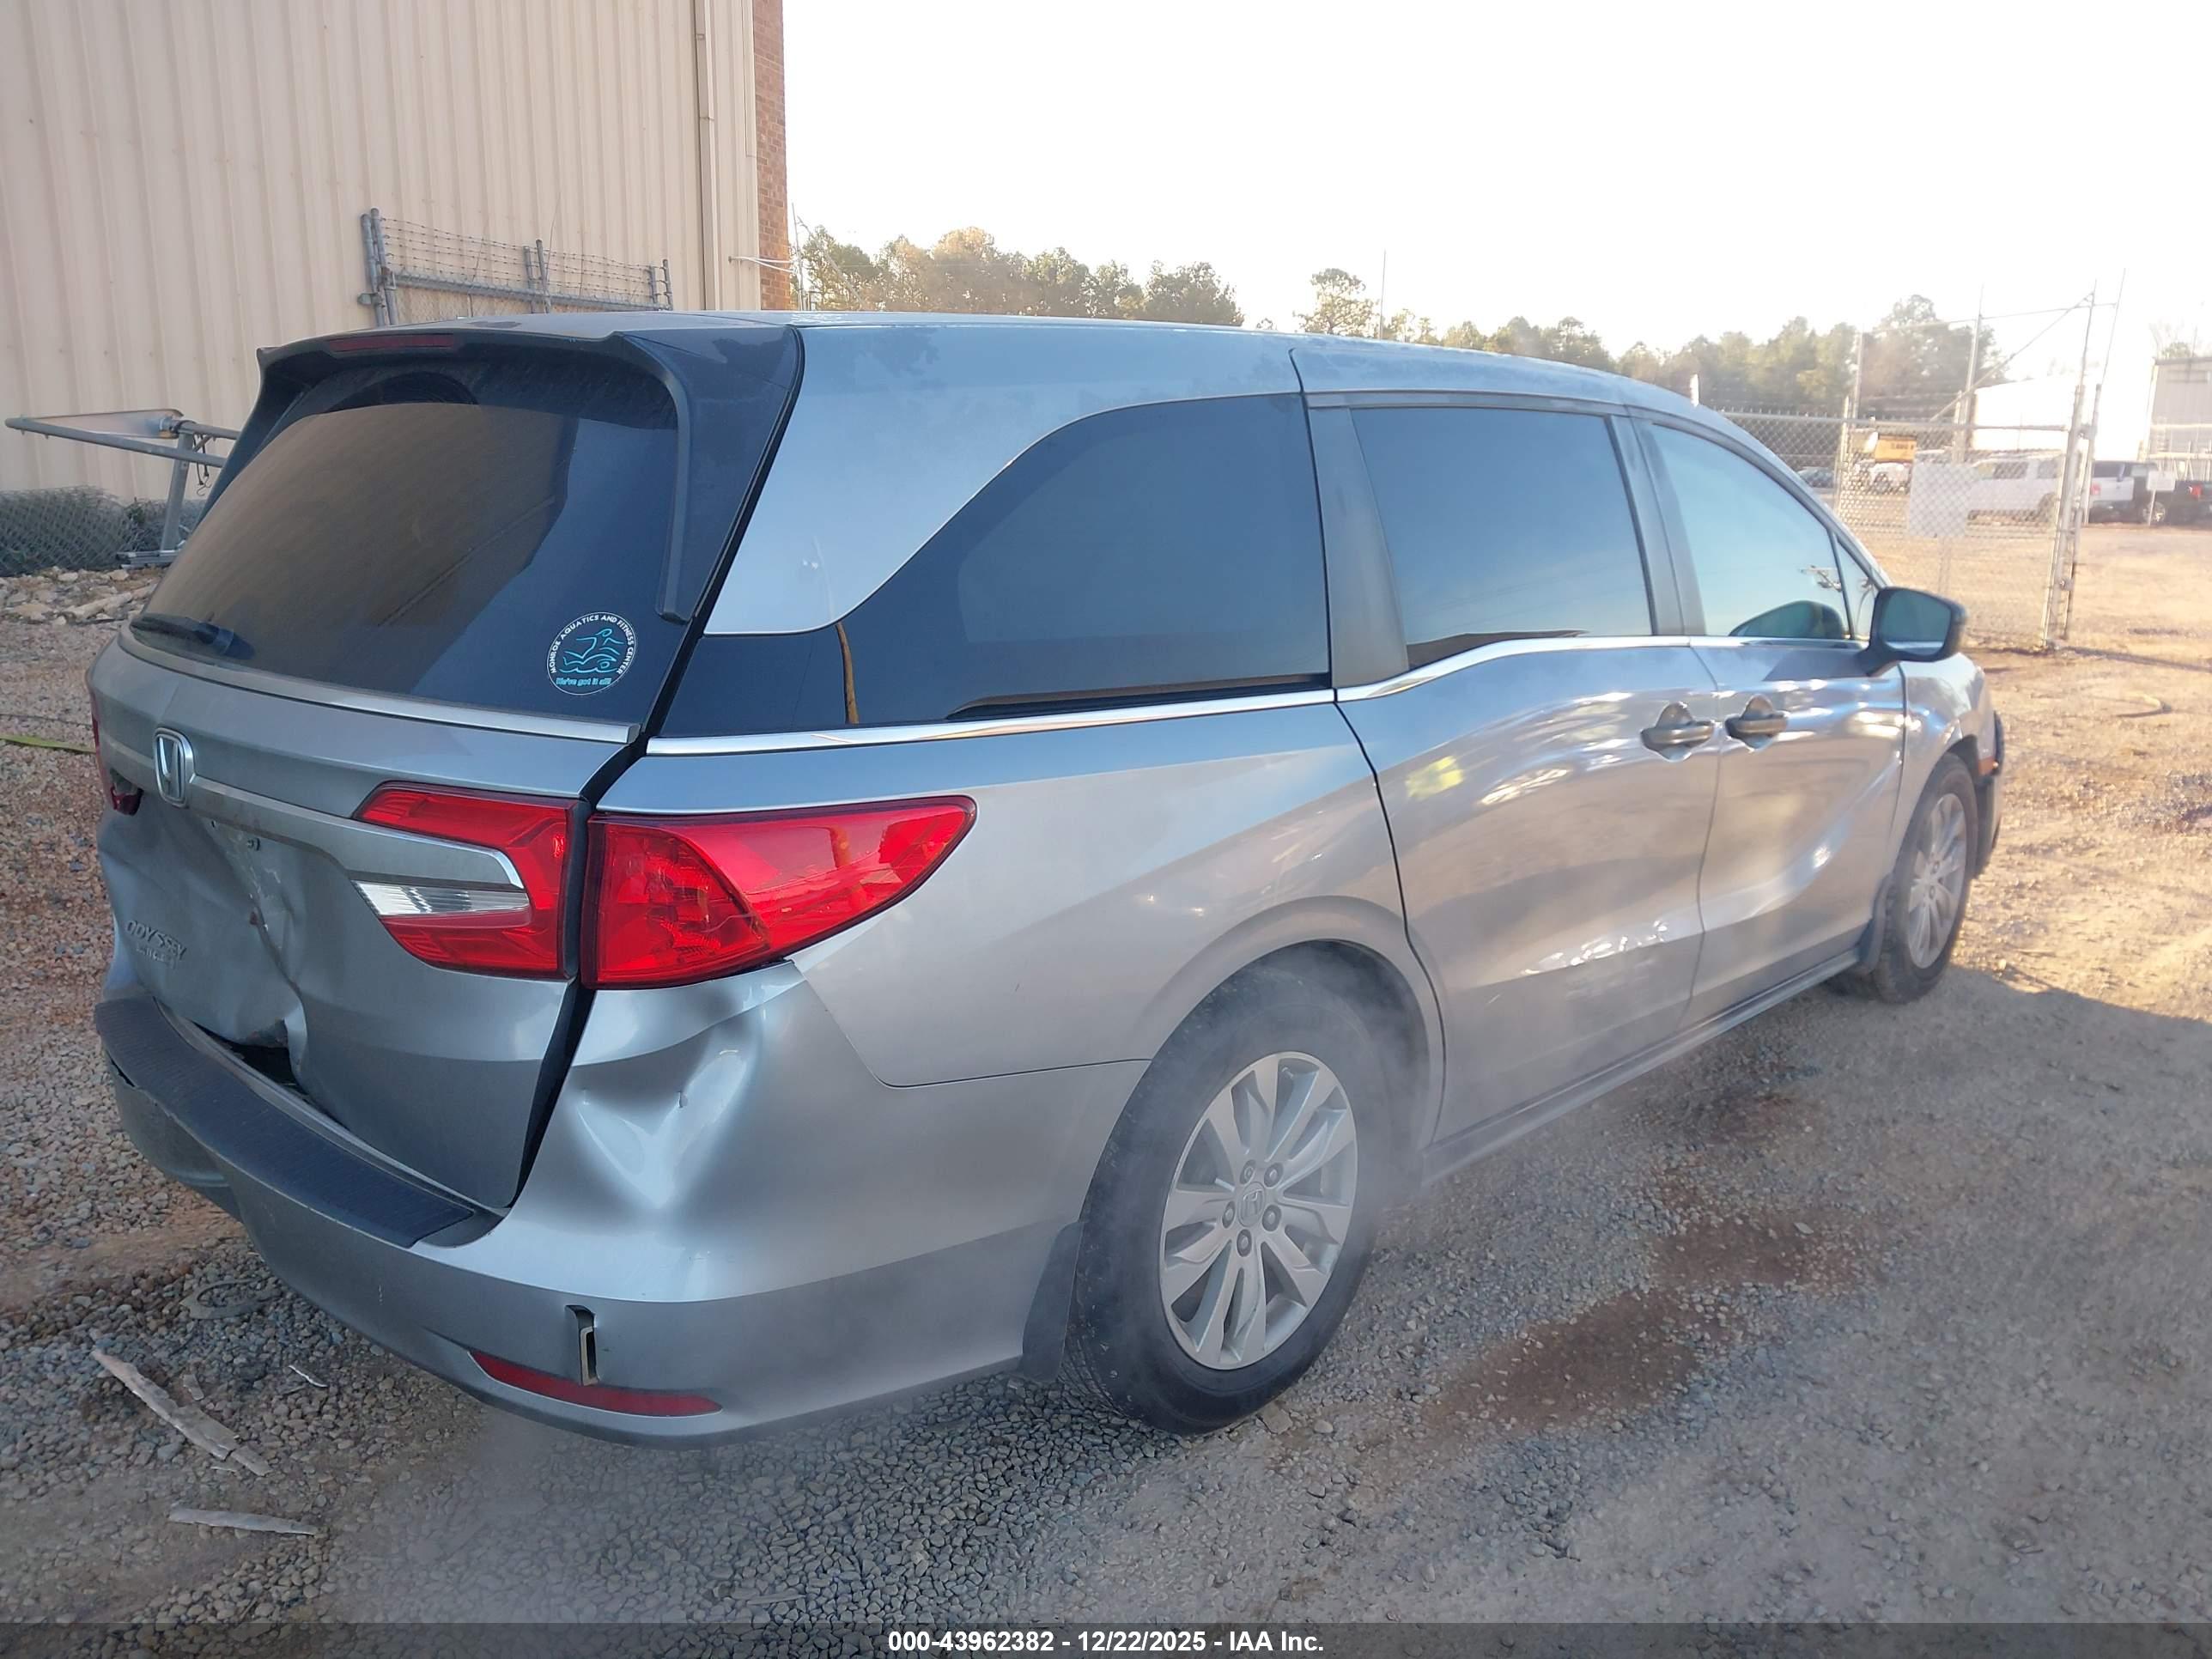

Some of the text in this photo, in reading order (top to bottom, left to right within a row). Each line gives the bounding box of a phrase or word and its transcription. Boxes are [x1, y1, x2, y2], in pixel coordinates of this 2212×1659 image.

[549, 614, 635, 675] MONROE AQUATICS AND FITNESS CENTER
[124, 919, 187, 960] ODYSSEY
